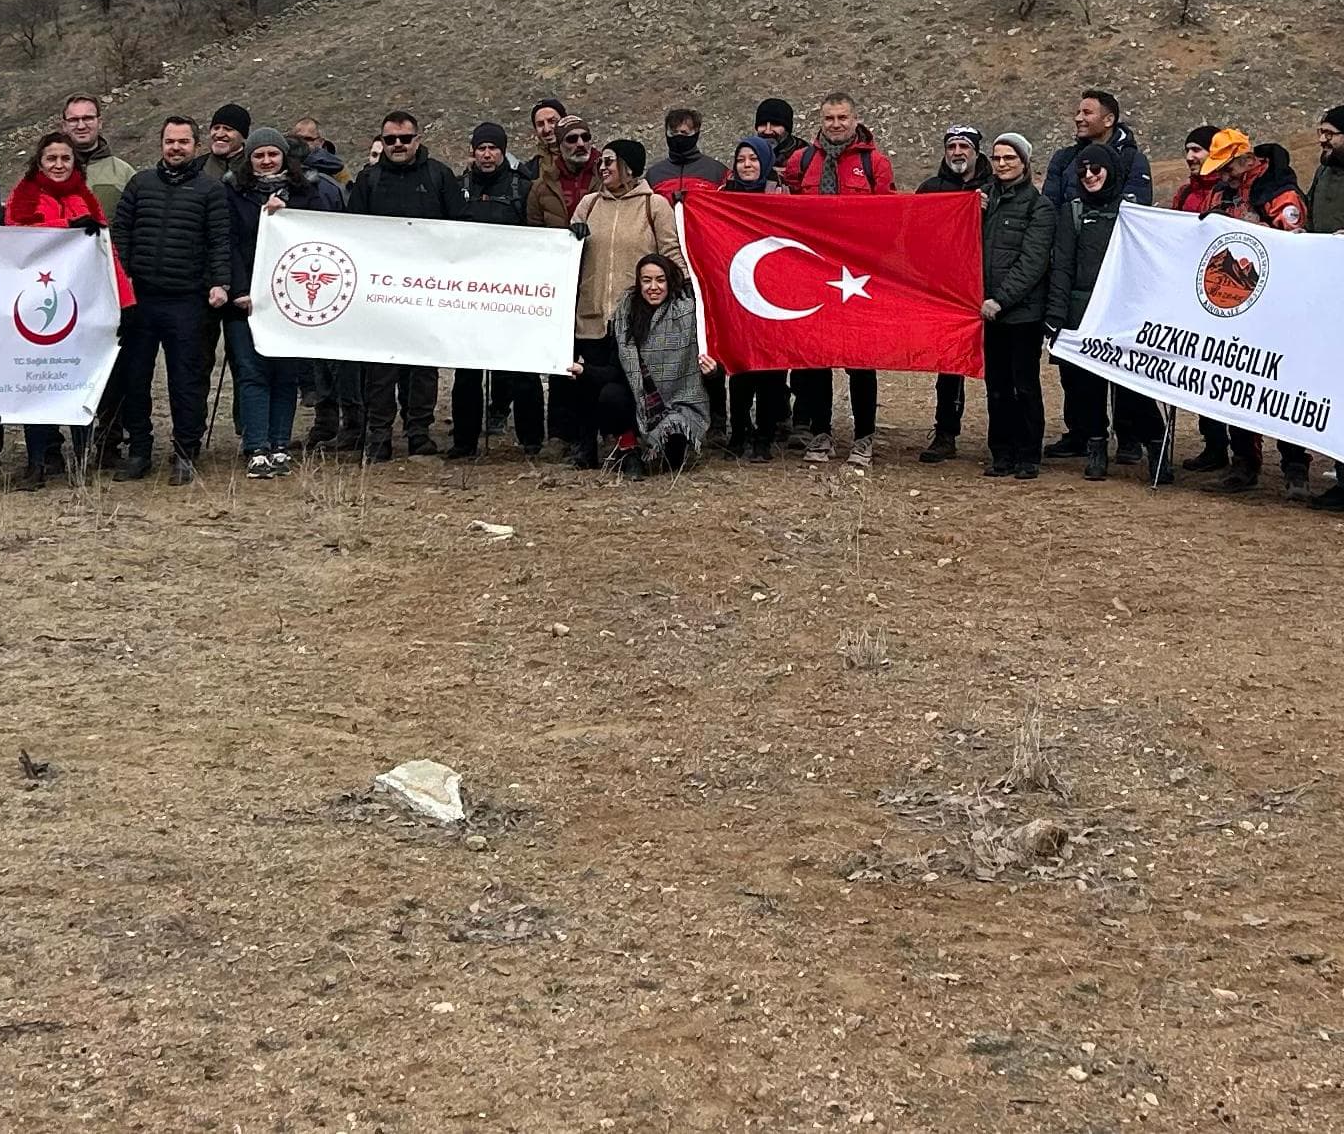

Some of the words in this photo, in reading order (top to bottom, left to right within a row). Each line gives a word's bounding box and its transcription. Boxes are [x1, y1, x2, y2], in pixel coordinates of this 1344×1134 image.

[366, 293, 423, 307] KIRIKKALE
[426, 296, 434, 307] İL
[437, 298, 479, 311] SAĞLIK
[480, 301, 553, 317] MÜDÜRLÜĞÜ
[402, 276, 463, 292] SAĞLIK
[467, 281, 556, 298] BAKANLIĞI
[1136, 321, 1200, 359] BOZKIR
[1201, 336, 1284, 380] DAĞCILIK
[1079, 337, 1123, 367] DOĞA
[1124, 349, 1207, 395] SPORLARI
[1209, 373, 1256, 410] SPOR
[1256, 386, 1331, 432] KULÜBÜ
